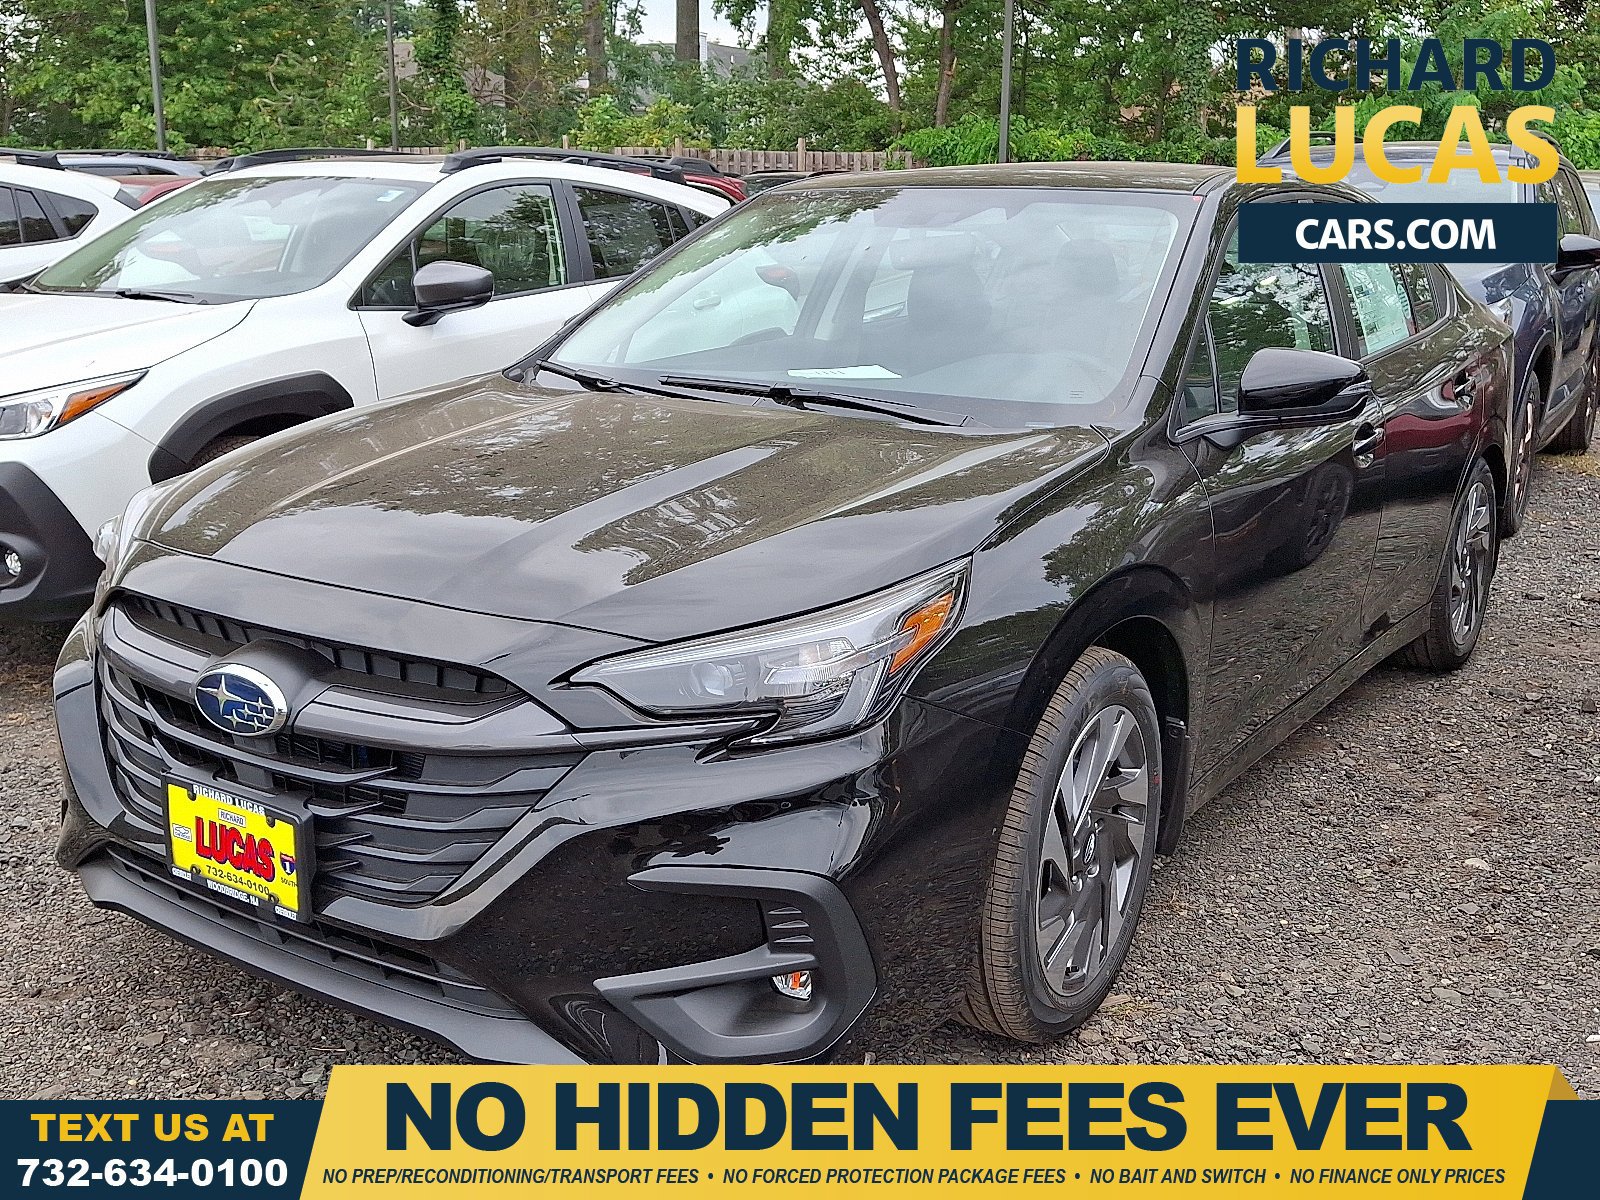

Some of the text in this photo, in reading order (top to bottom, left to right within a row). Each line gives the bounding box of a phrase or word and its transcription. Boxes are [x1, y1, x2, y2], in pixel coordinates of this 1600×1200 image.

[193, 784, 265, 815] RICHARD LUCAS
[220, 811, 244, 826] RICHARD
[195, 816, 275, 882] LUCAS
[206, 864, 270, 896] 732-634-0100
